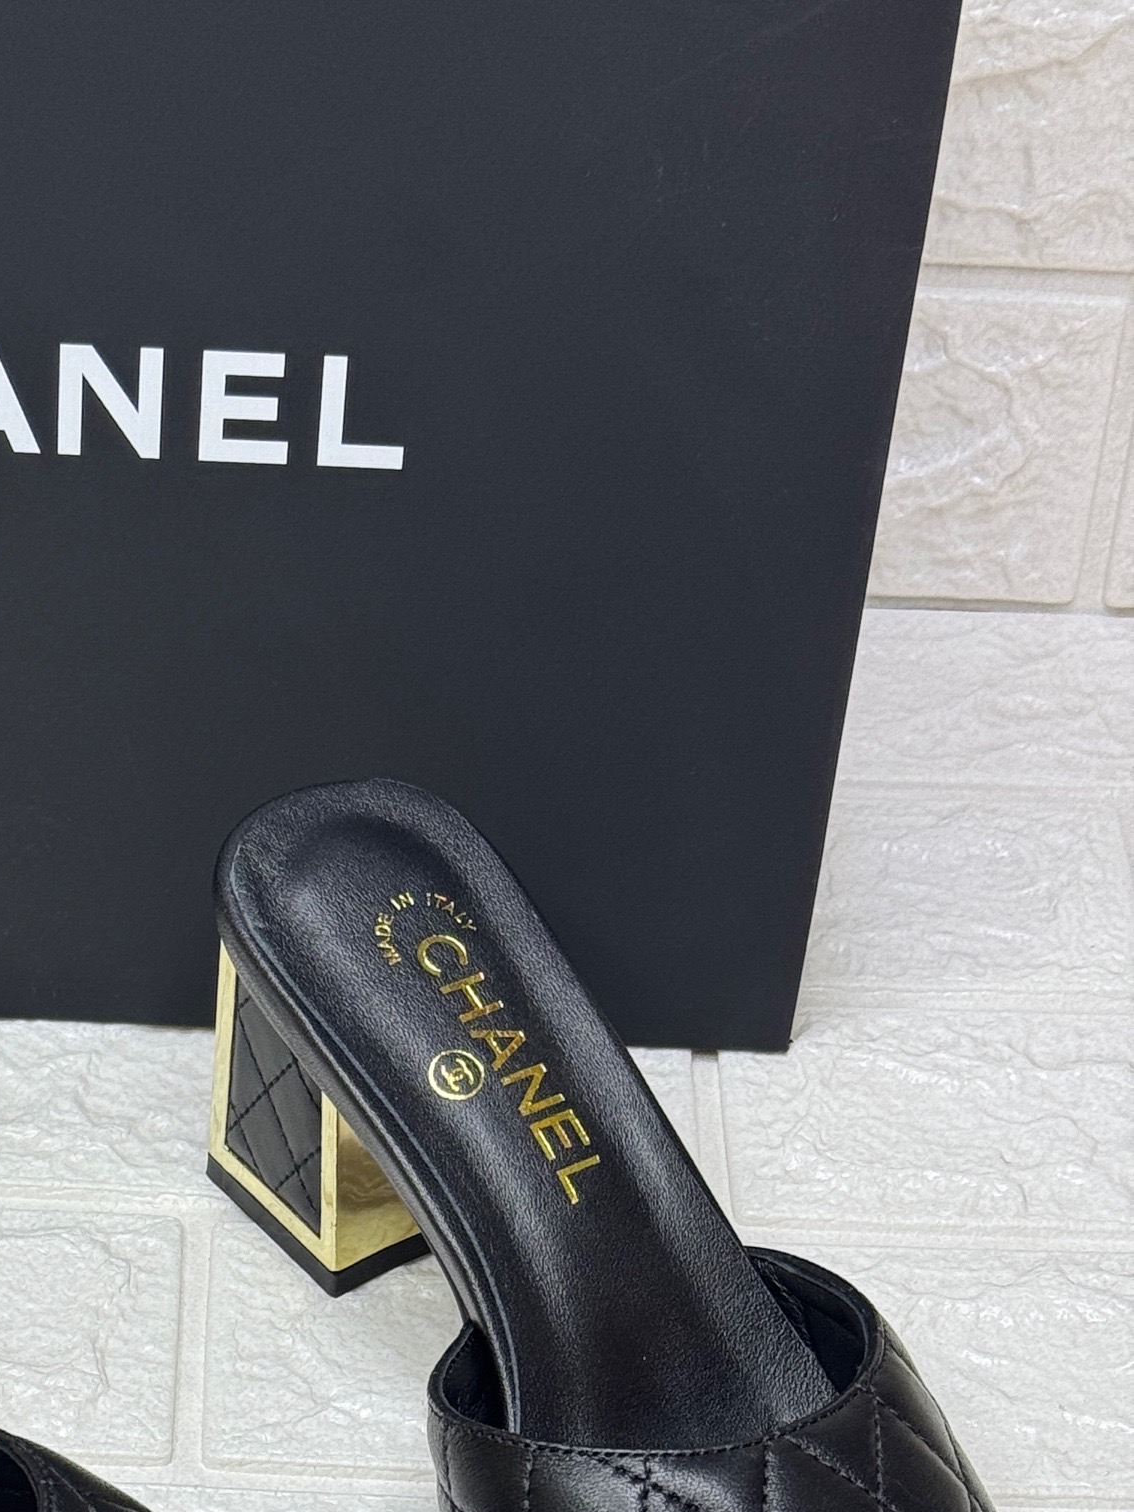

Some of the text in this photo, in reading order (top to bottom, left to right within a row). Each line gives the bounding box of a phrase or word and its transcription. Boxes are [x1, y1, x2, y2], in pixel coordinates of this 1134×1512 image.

[374, 891, 477, 966] MADE IN ITALY
[417, 934, 601, 1205] CHANEL
